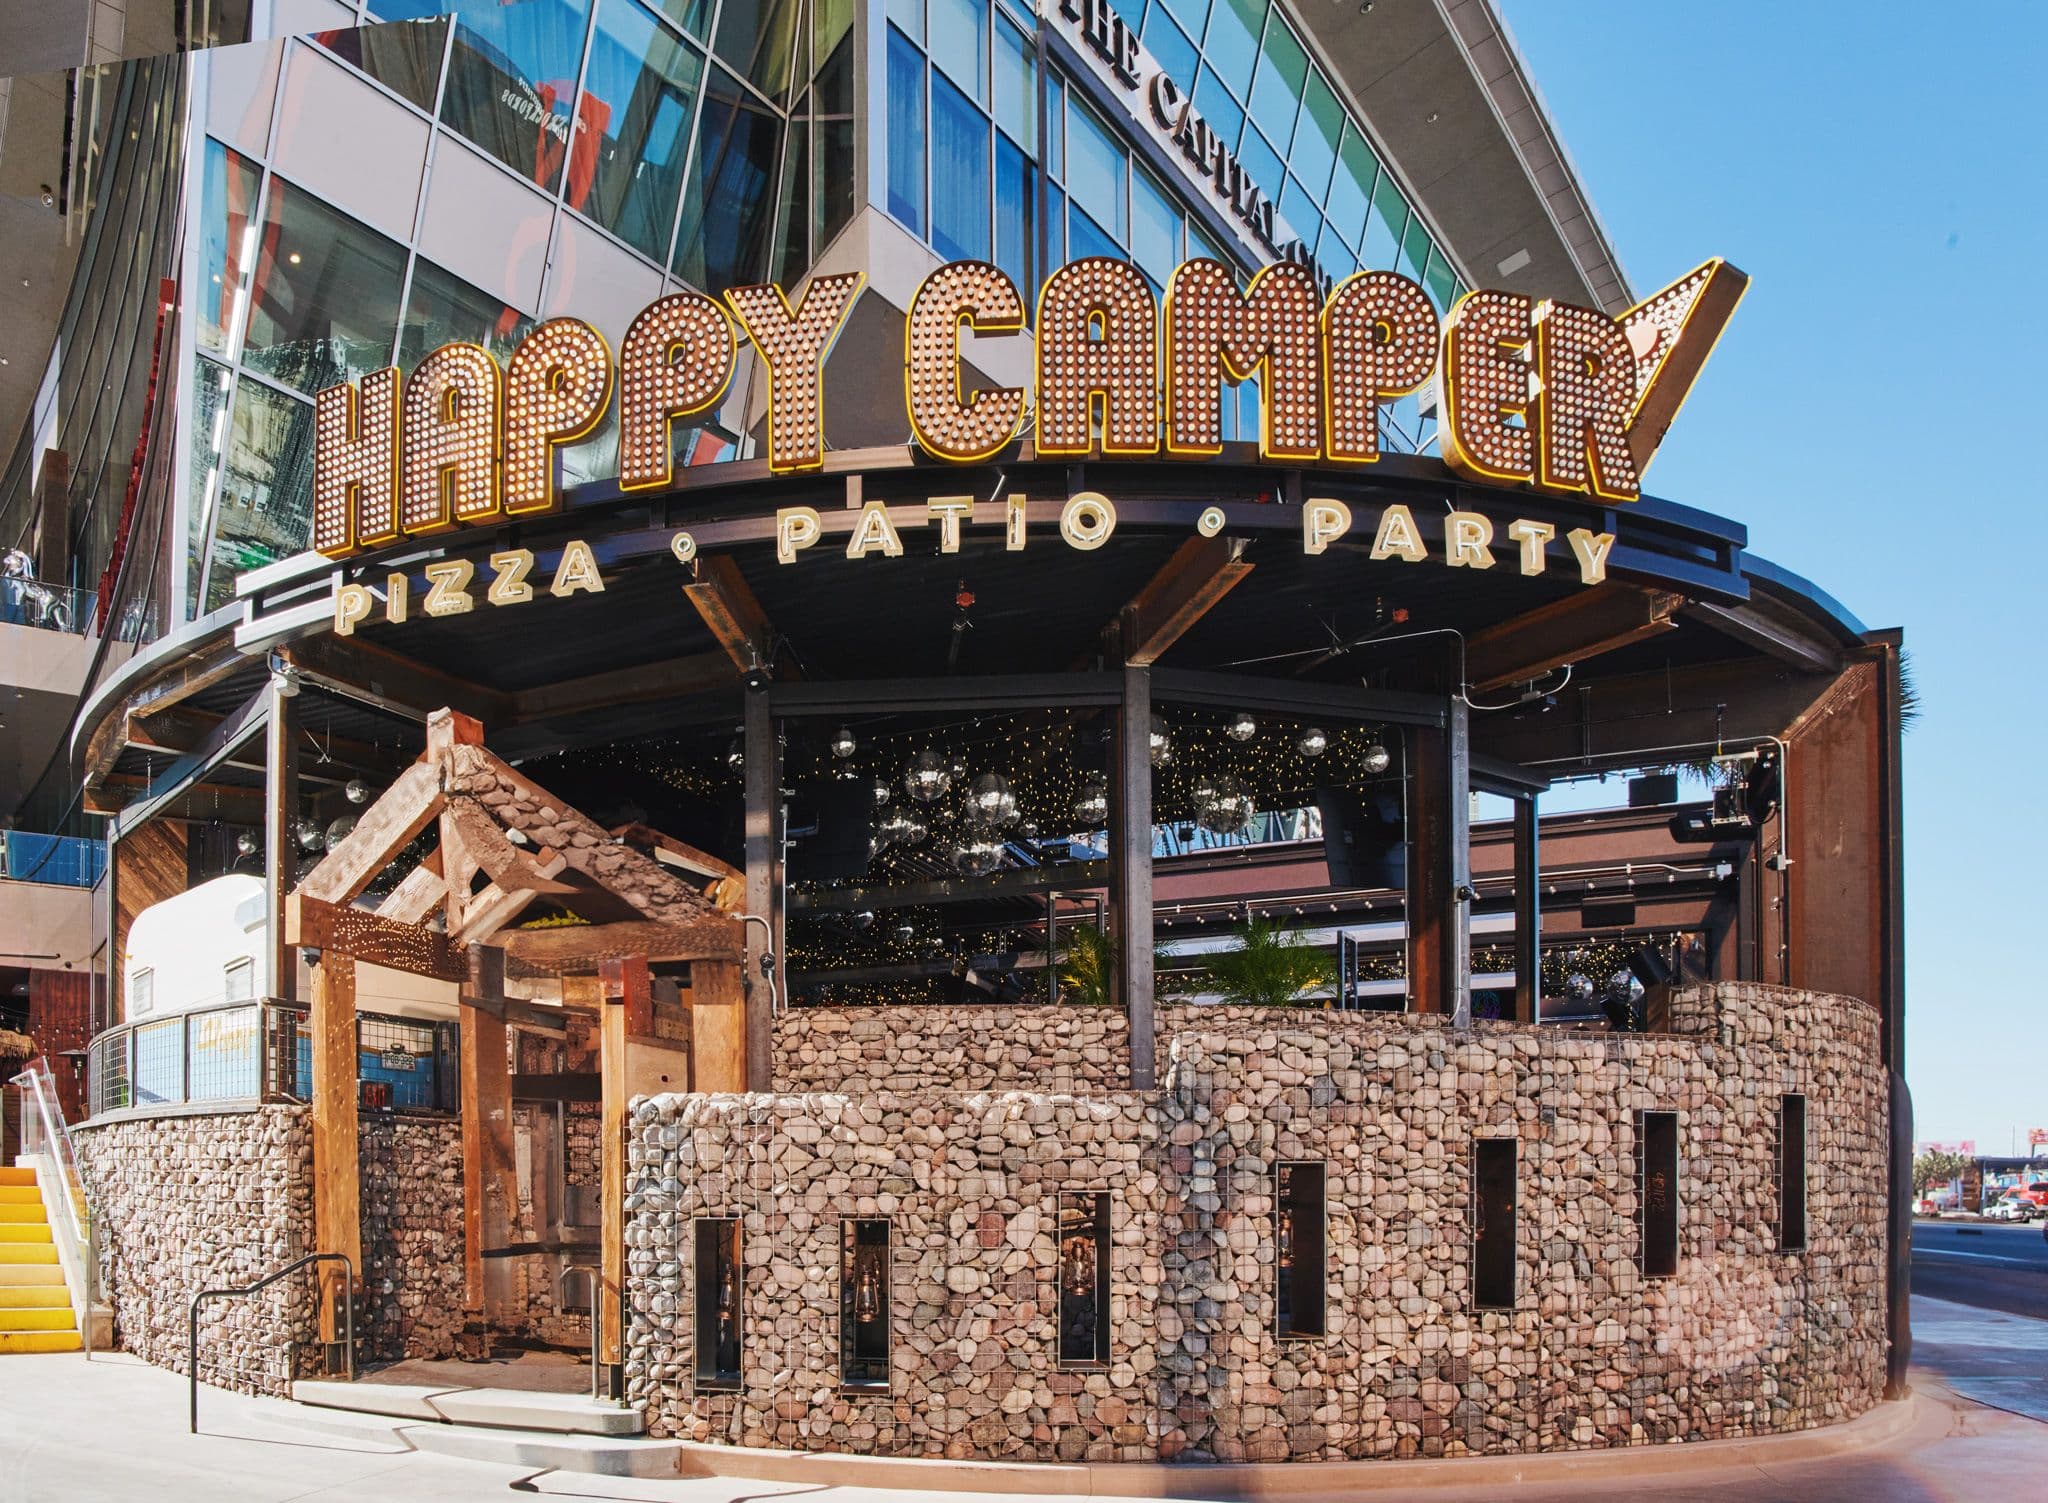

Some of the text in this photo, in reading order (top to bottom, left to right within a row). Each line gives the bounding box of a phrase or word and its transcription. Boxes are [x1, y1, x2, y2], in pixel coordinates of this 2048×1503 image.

[1059, 0, 1286, 262] HE CAPITAL
[315, 257, 1640, 557] HAPPY CAMPER
[334, 492, 1615, 636] PIZZA PATIO PARTY
[364, 1082, 386, 1107] EXIT
